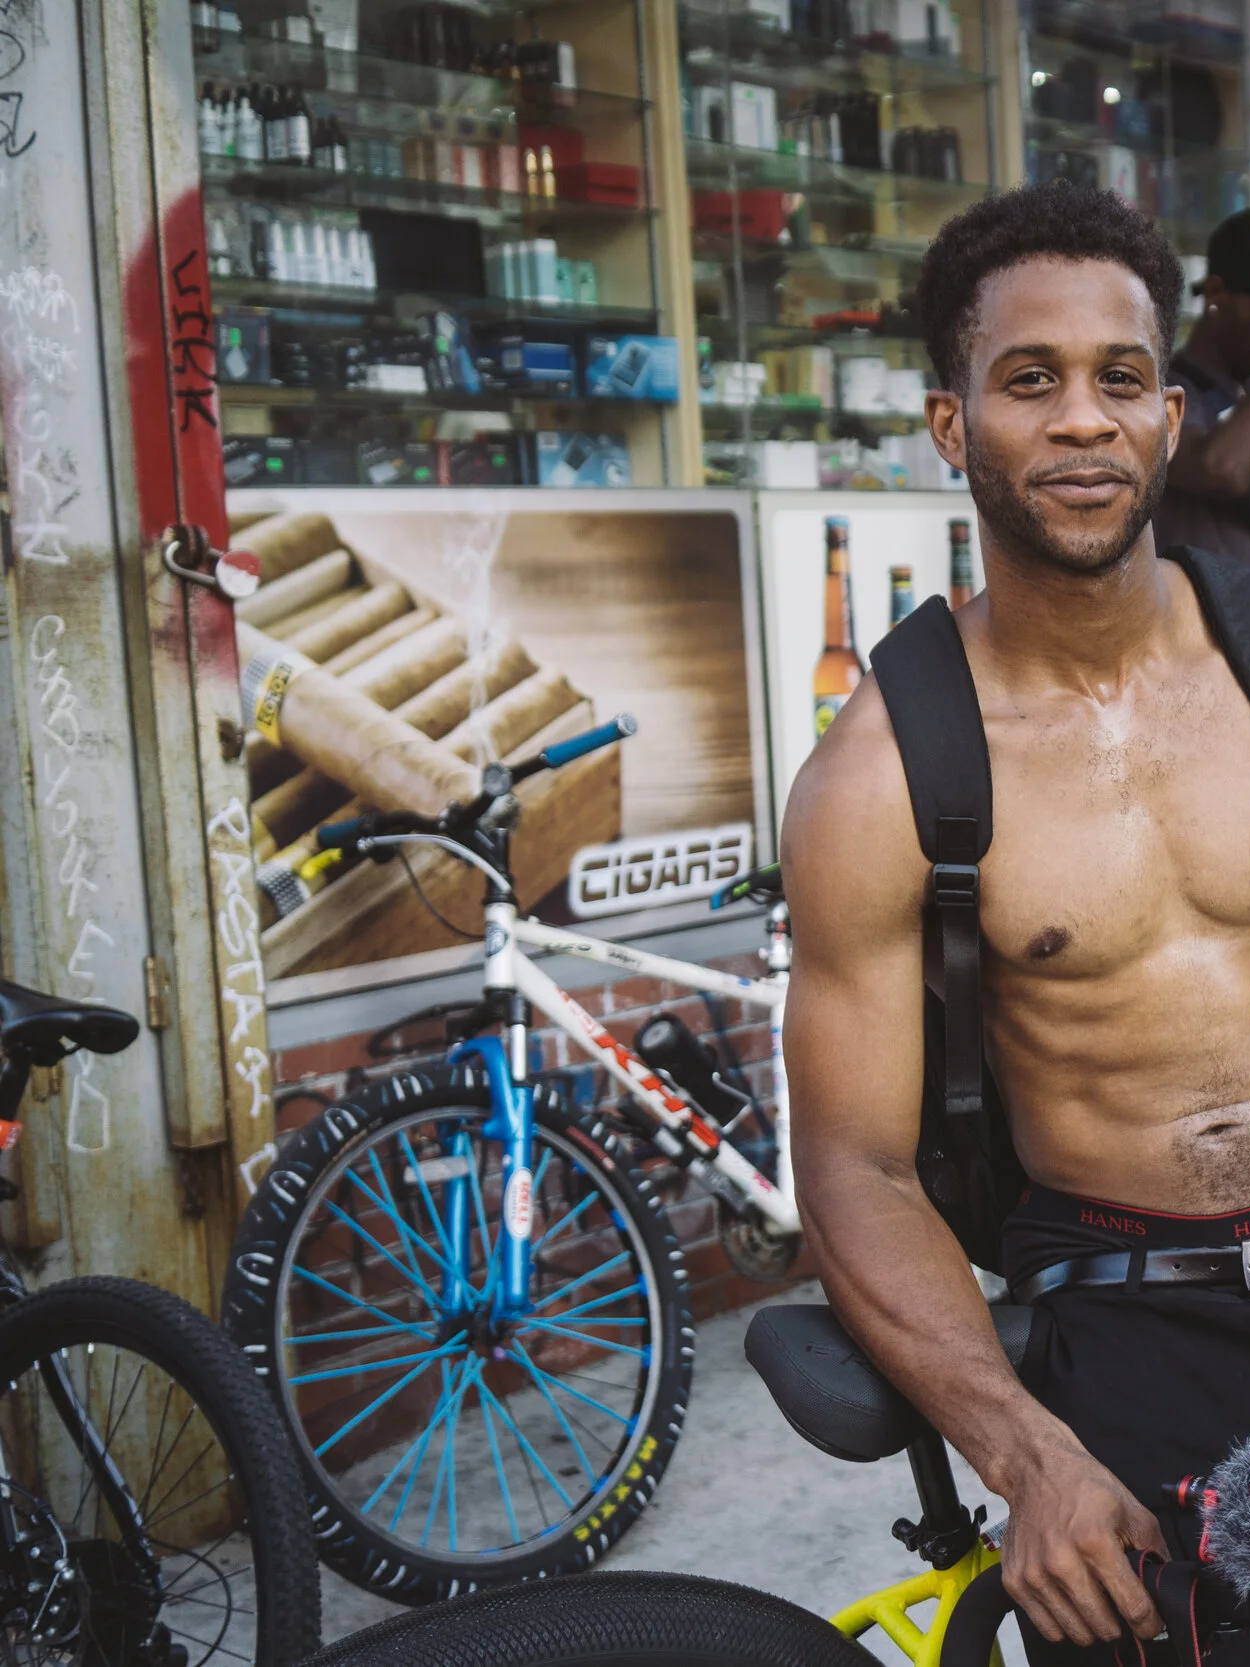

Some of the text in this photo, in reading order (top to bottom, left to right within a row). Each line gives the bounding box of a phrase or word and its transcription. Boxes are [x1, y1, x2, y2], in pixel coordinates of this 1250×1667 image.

[581, 834, 742, 903] CIGARS
[1080, 1208, 1147, 1236] HANES
[573, 1435, 657, 1542] MAXXIS
